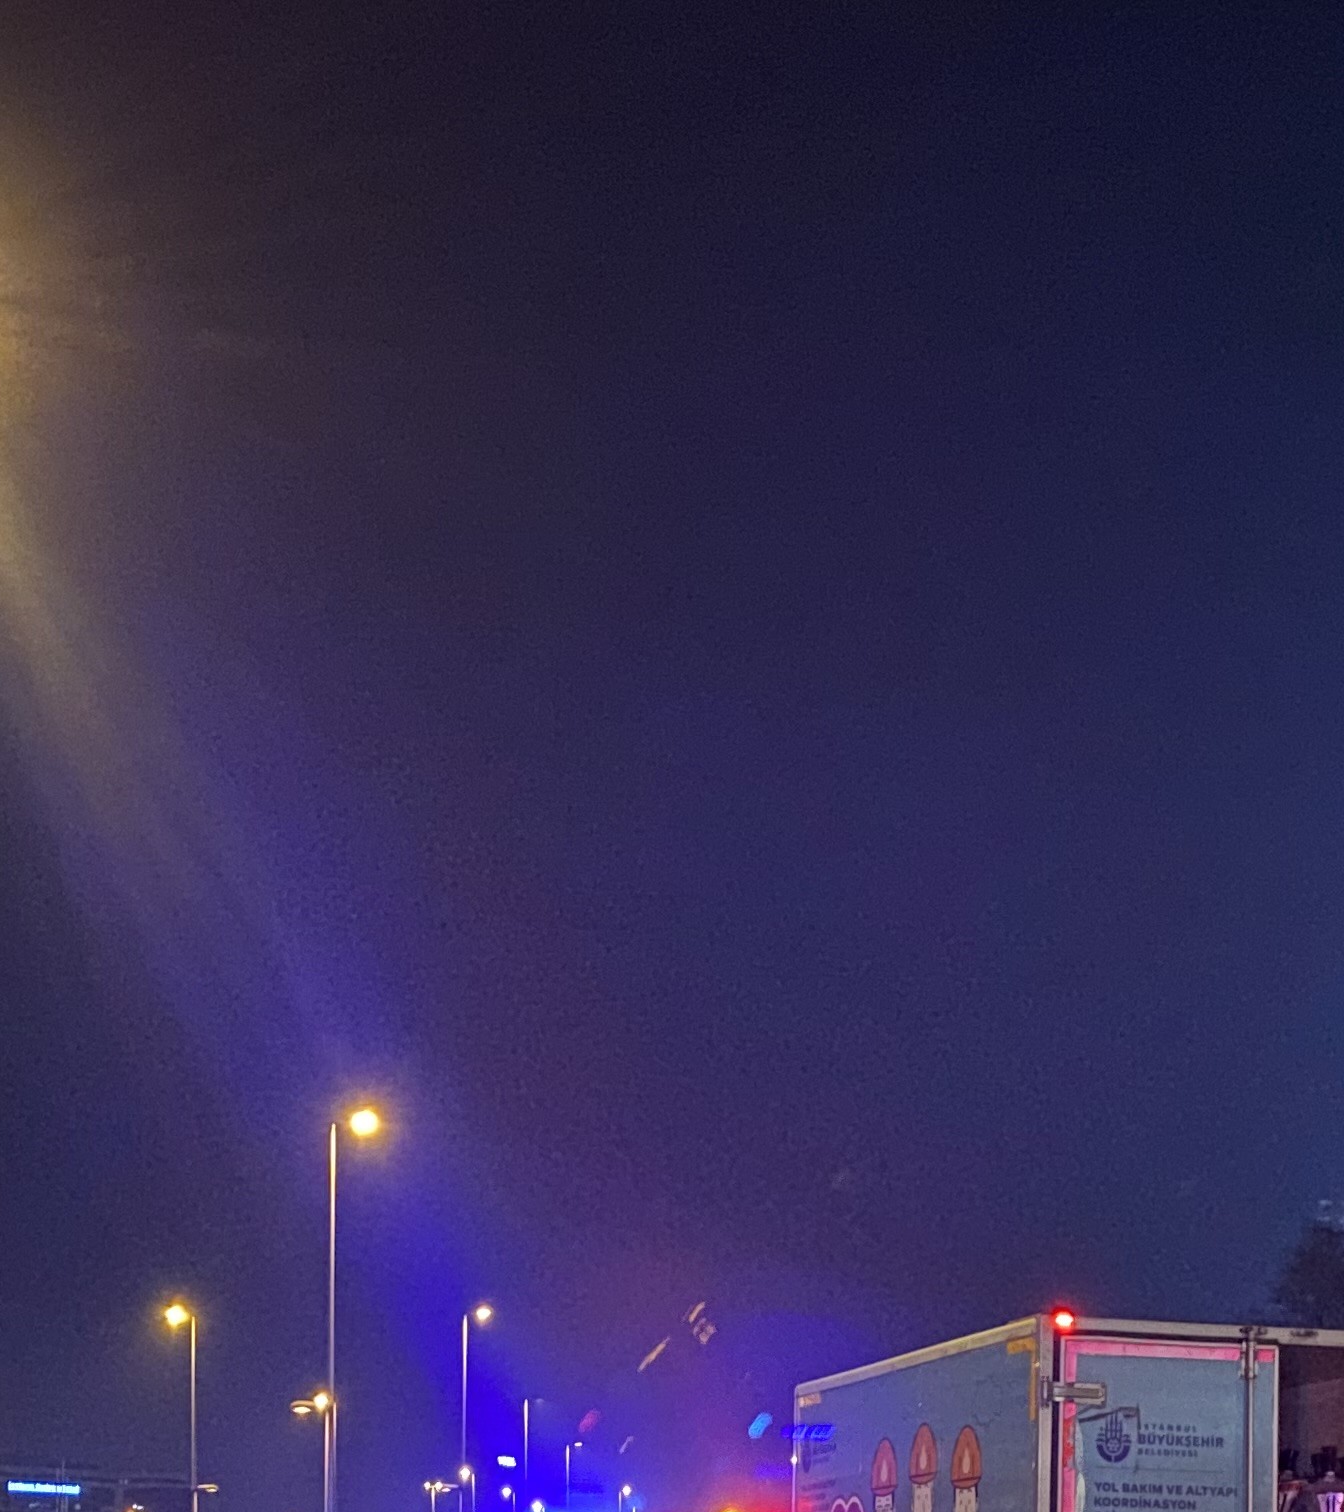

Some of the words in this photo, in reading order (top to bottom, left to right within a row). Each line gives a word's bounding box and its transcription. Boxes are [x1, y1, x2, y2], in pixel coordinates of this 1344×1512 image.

[1094, 1482, 1118, 1493] YOL
[1121, 1483, 1163, 1495] BAKIM
[1166, 1485, 1183, 1496] VE
[1185, 1486, 1237, 1498] ALTYAPI
[1094, 1496, 1197, 1510] KOORDİNASYON
